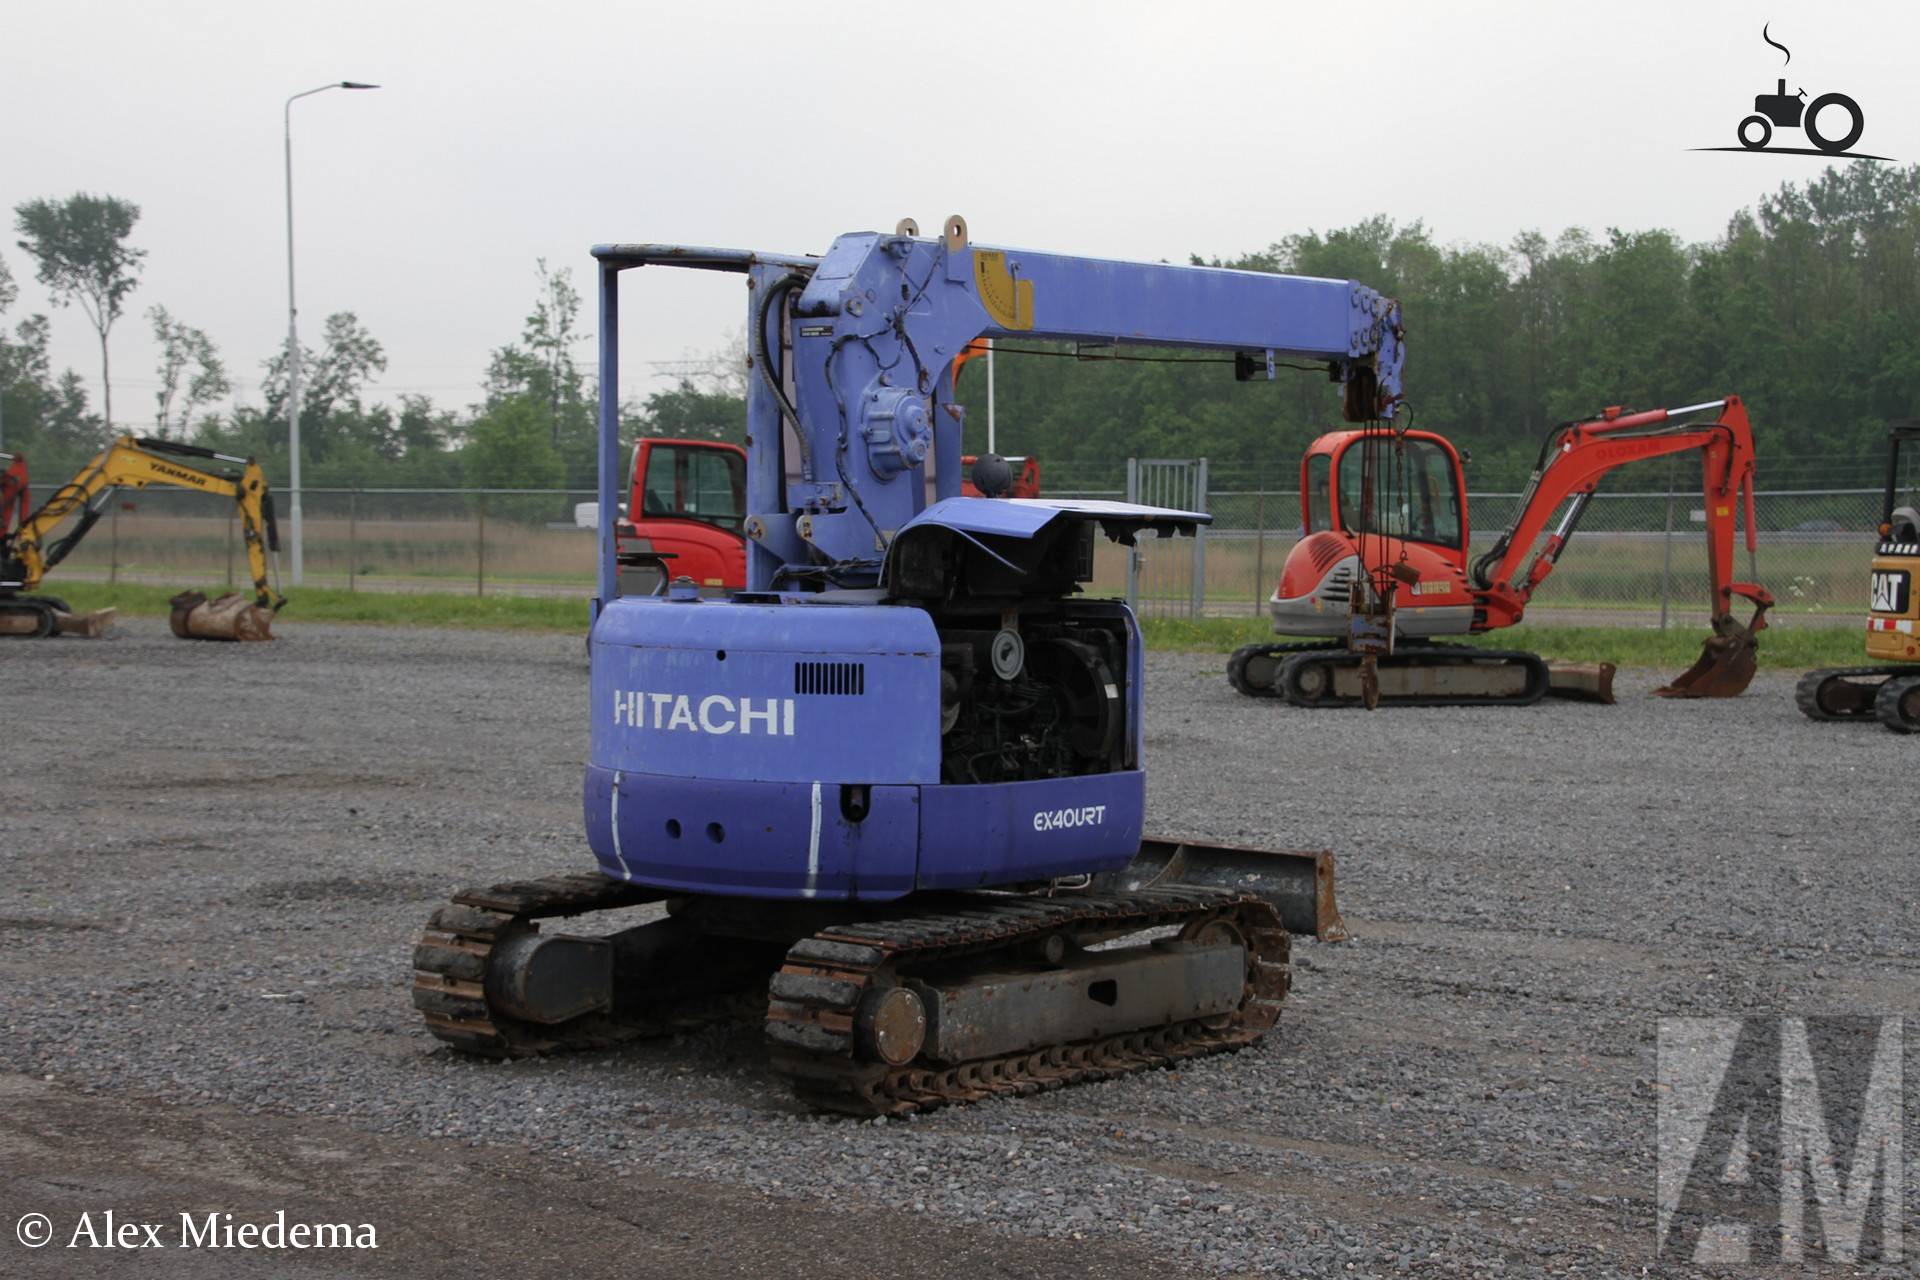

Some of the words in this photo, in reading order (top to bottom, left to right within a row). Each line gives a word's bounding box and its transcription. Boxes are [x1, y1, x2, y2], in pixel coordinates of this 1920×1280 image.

[151, 462, 207, 486] YANMAR
[1871, 573, 1902, 611] CAT
[614, 690, 795, 735] HITACHI
[1033, 805, 1106, 832] EX40URT
